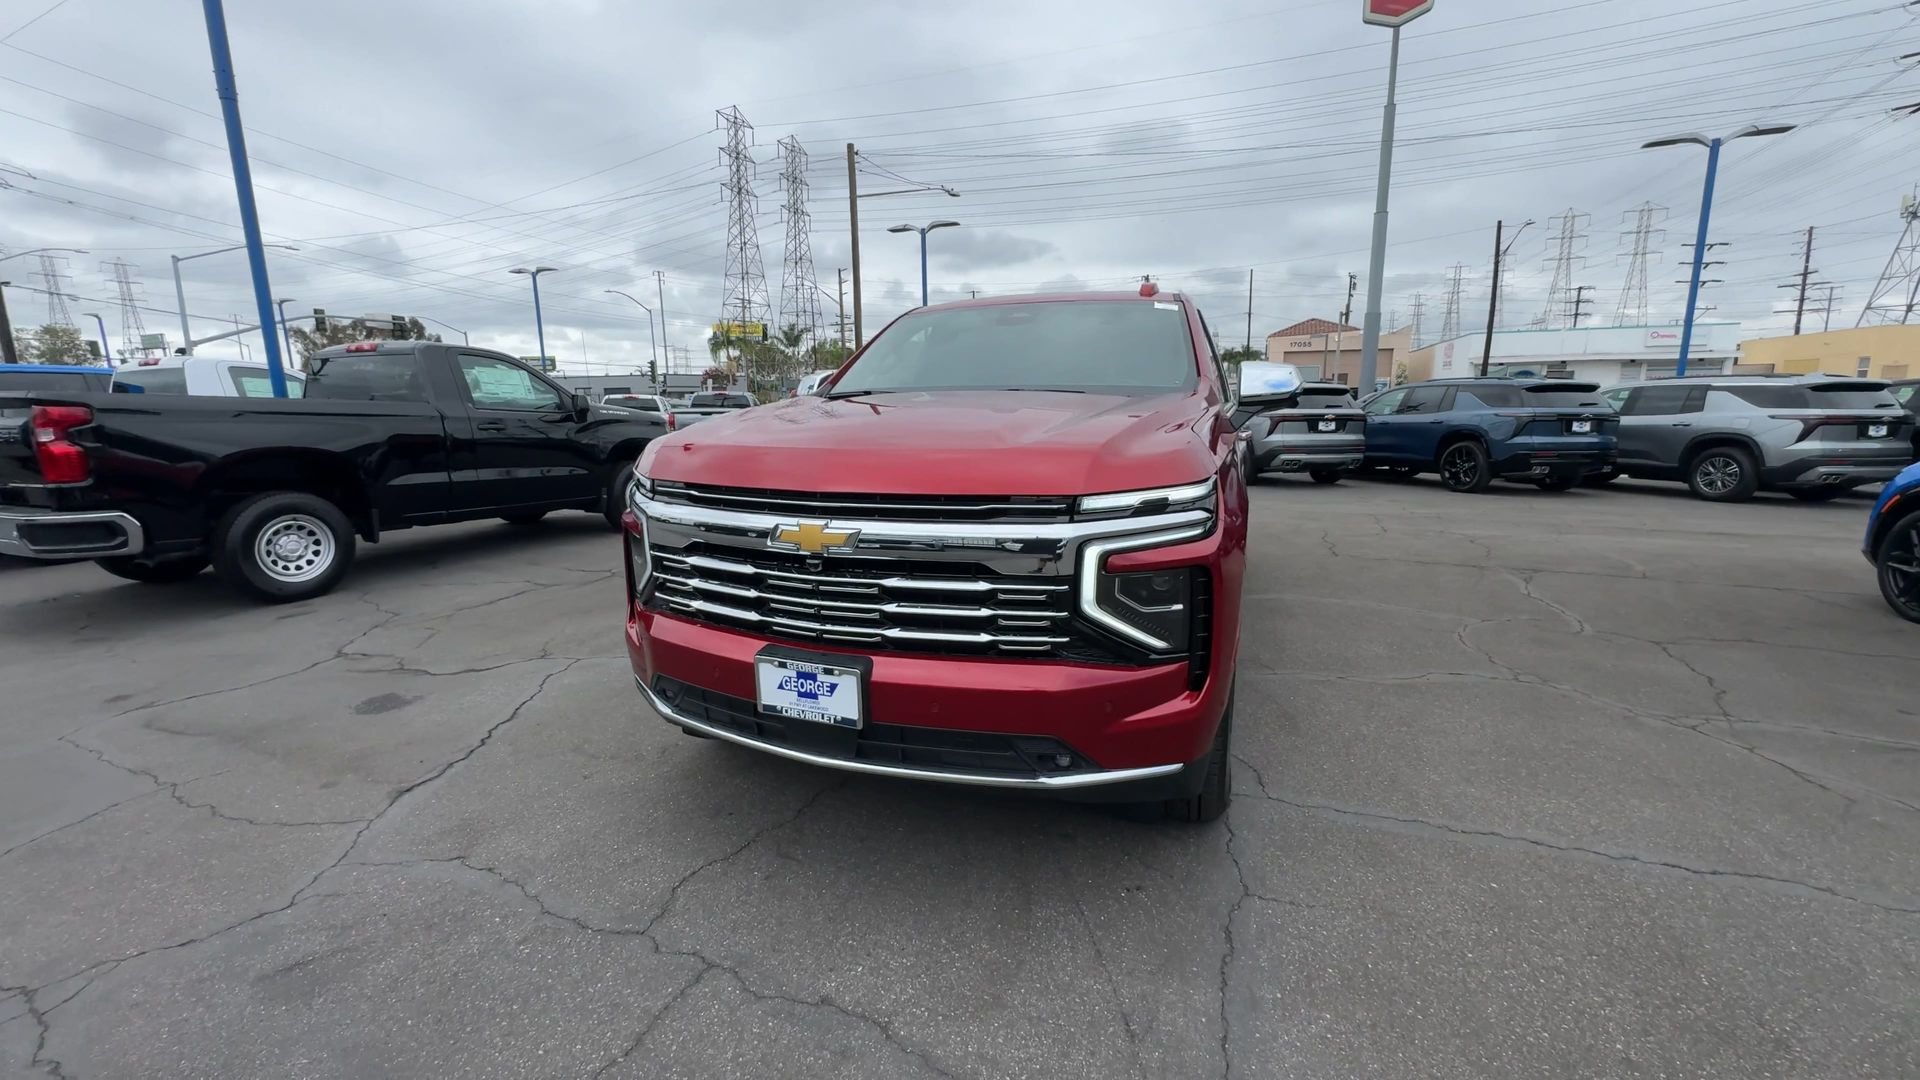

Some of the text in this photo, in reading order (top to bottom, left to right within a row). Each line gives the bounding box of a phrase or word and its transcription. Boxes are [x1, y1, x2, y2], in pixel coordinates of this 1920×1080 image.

[786, 662, 824, 674] GEORGE
[782, 676, 831, 696] GEORGE
[782, 707, 836, 724] CHEVROLET
